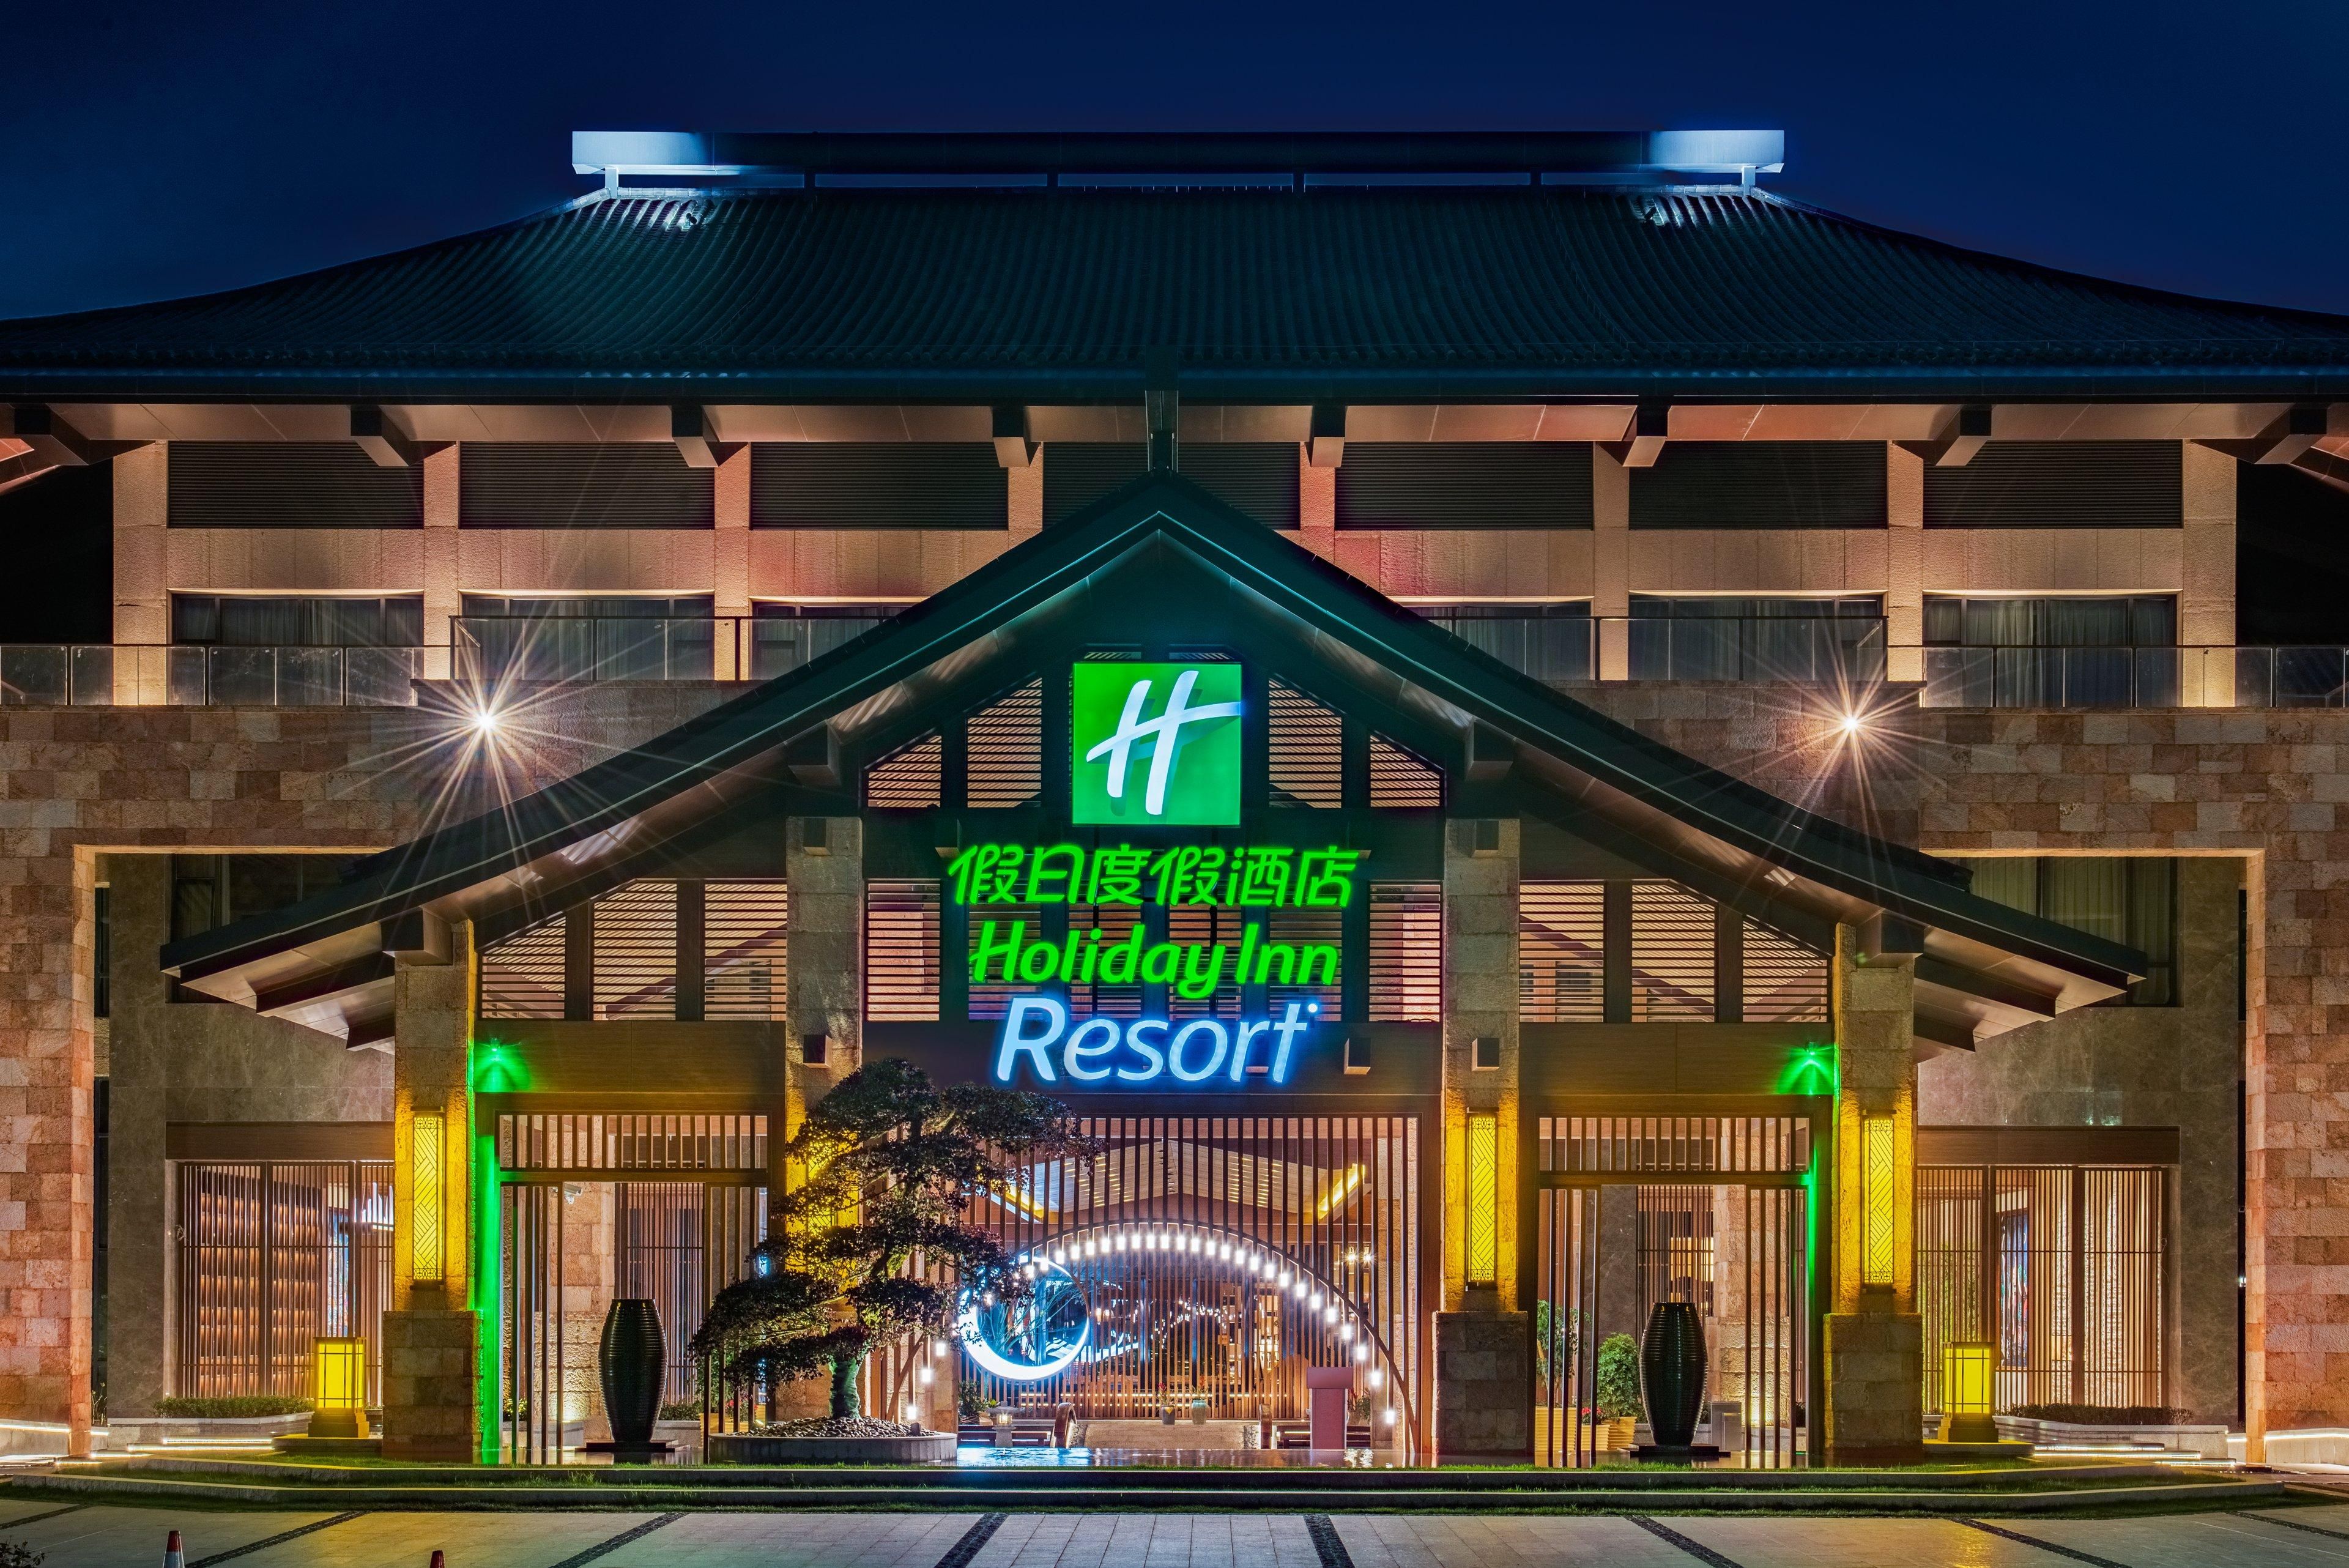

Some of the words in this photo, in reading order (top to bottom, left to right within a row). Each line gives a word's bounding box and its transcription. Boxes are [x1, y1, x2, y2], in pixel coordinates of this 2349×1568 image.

[1086, 671, 1241, 816] H
[949, 844, 1359, 907] 假日度假酒店
[969, 921, 1225, 998] Holiday
[1235, 924, 1339, 984] Inn
[996, 997, 1308, 1084] Resort
